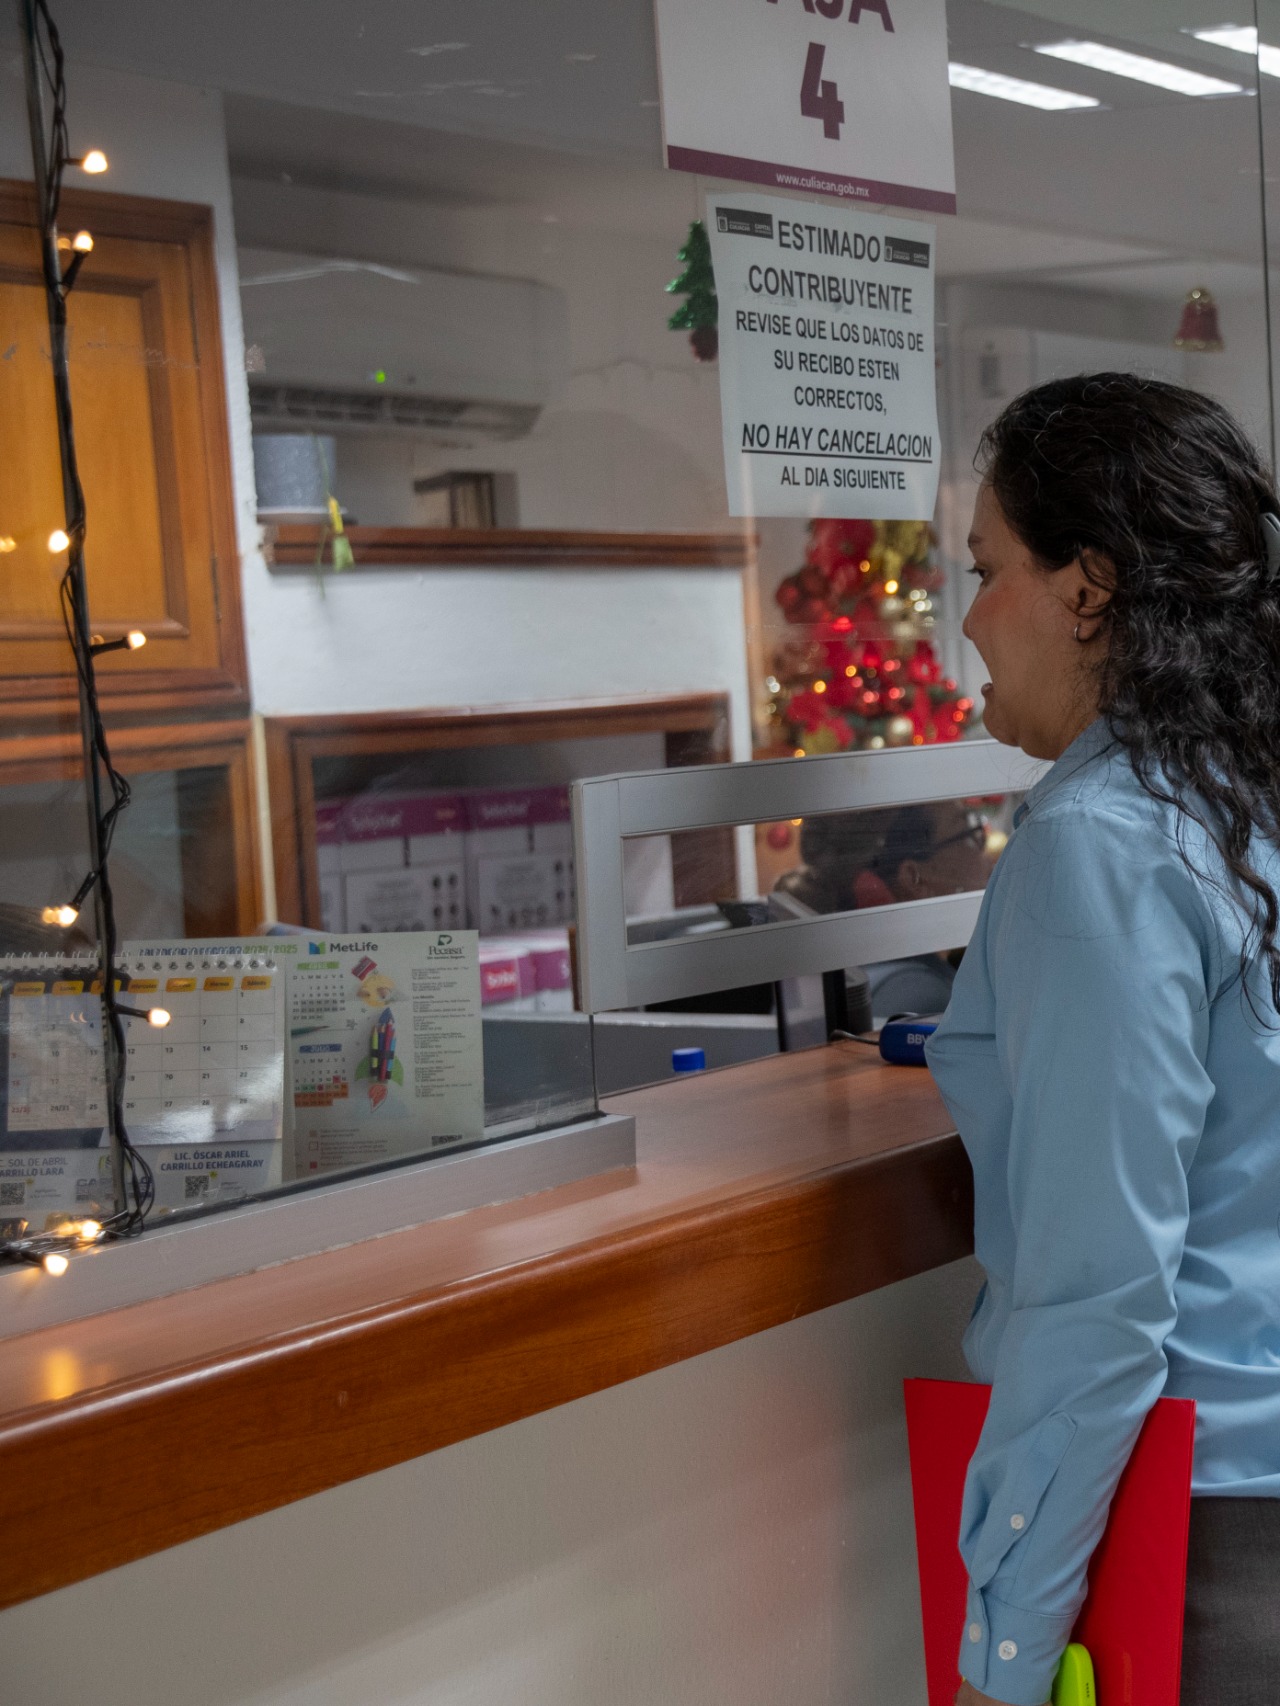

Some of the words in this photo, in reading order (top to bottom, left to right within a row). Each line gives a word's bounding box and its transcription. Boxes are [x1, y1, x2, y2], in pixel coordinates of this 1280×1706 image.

[800, 41, 845, 140] 4
[776, 172, 869, 197] www.culiacan.gob.mx
[778, 220, 881, 262] ESTIMADO
[748, 265, 913, 314] CONTRIBUYENTE
[736, 310, 791, 336] REVISE
[795, 317, 827, 340] QUE
[830, 321, 860, 344] LOS
[863, 326, 904, 350] DATOS
[907, 332, 924, 352] DE
[774, 349, 794, 371] SU
[799, 352, 854, 376] RECIBO
[859, 358, 900, 381] ESTEN
[794, 386, 887, 416] CORRECTOS,
[742, 423, 770, 449] NO
[775, 425, 813, 451] HAY
[817, 428, 932, 458] CANCELACION
[780, 466, 800, 486] AL
[805, 467, 830, 487] DIA
[833, 468, 906, 490] SIGUIENTE
[330, 941, 379, 953] MetLife
[906, 1033, 931, 1045] BBV
[8, 1158, 26, 1167] SOL
[27, 1158, 40, 1166] DE
[42, 1157, 69, 1166] ABRIL
[160, 1162, 204, 1171] CARRILLO
[206, 1159, 265, 1170] ECHEAGARAY
[174, 1152, 191, 1161] LIC.
[224, 1150, 250, 1159] ARIEL
[0, 1168, 38, 1178] ARRILLO
[40, 1167, 65, 1176] LARA
